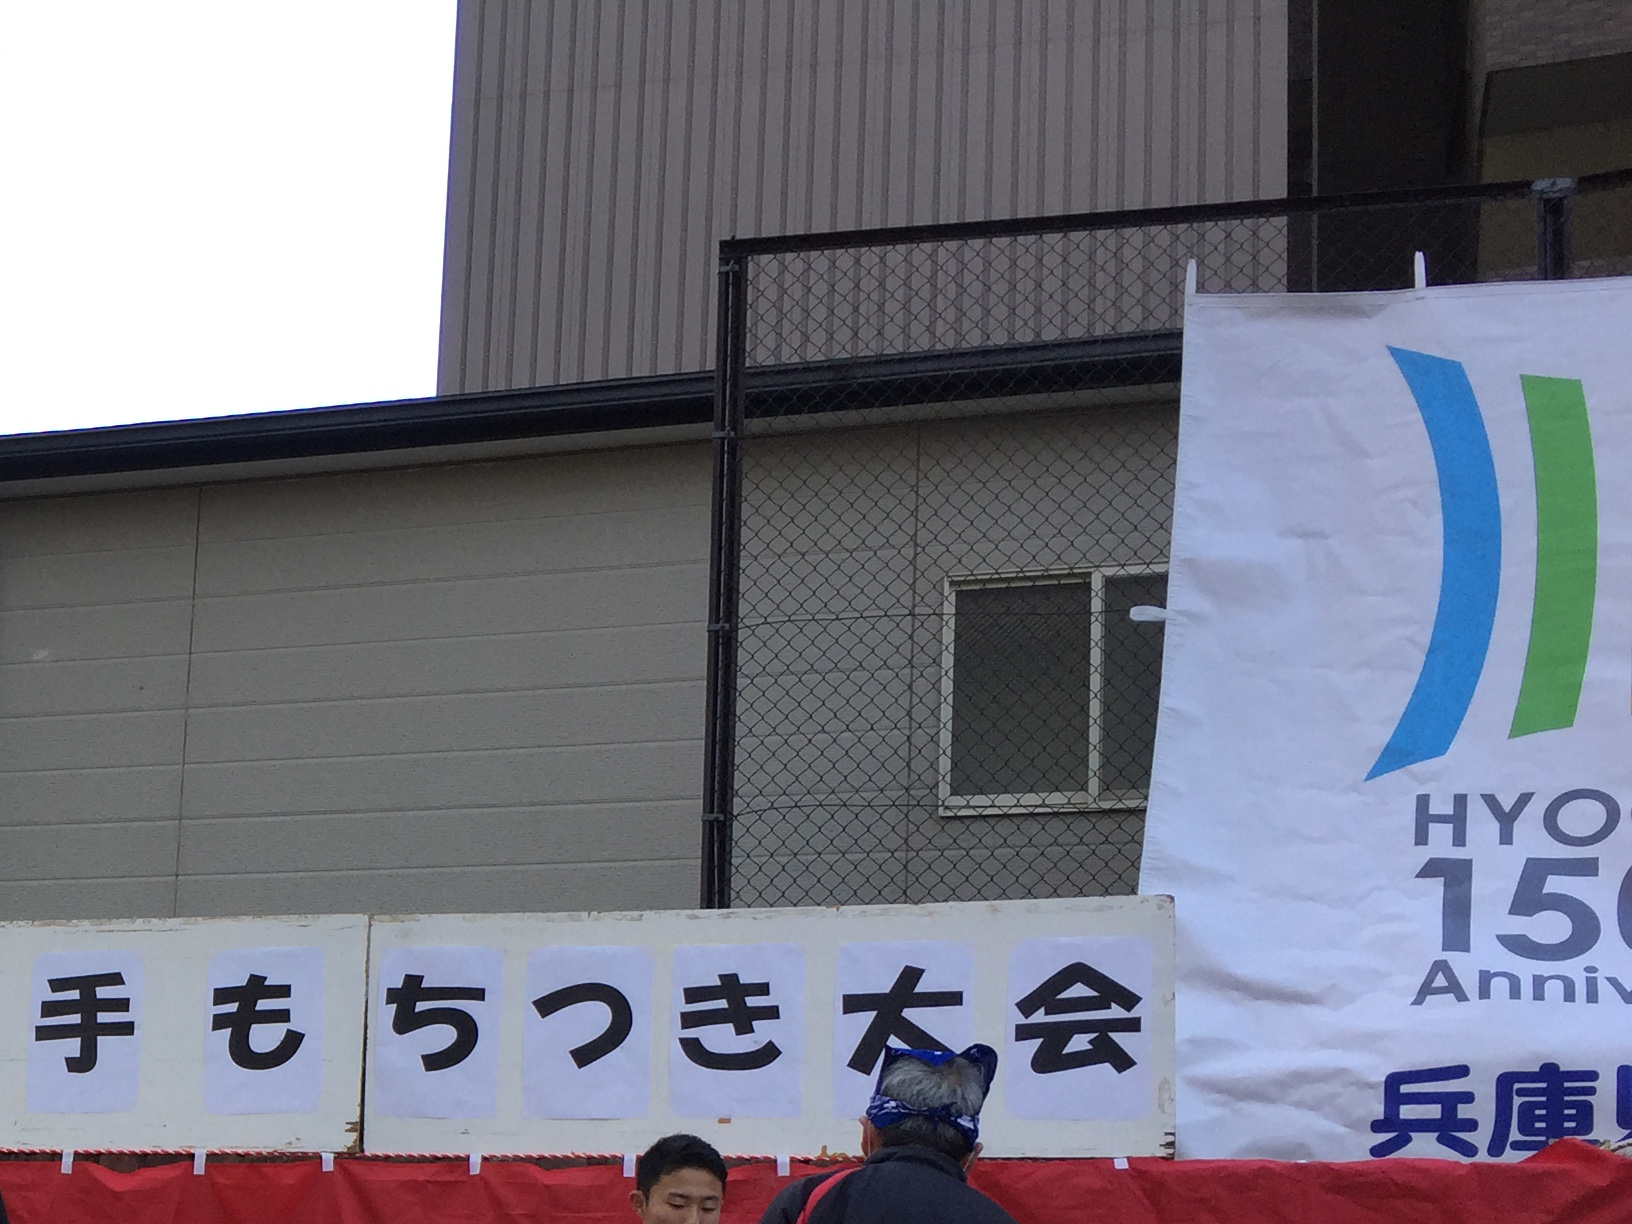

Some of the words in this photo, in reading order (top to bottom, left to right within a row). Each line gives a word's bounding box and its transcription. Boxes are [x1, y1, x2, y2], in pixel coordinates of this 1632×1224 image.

[1414, 788, 1632, 847] HYO
[1414, 857, 1632, 962] 15
[1369, 1062, 1632, 1158] 兵庫
